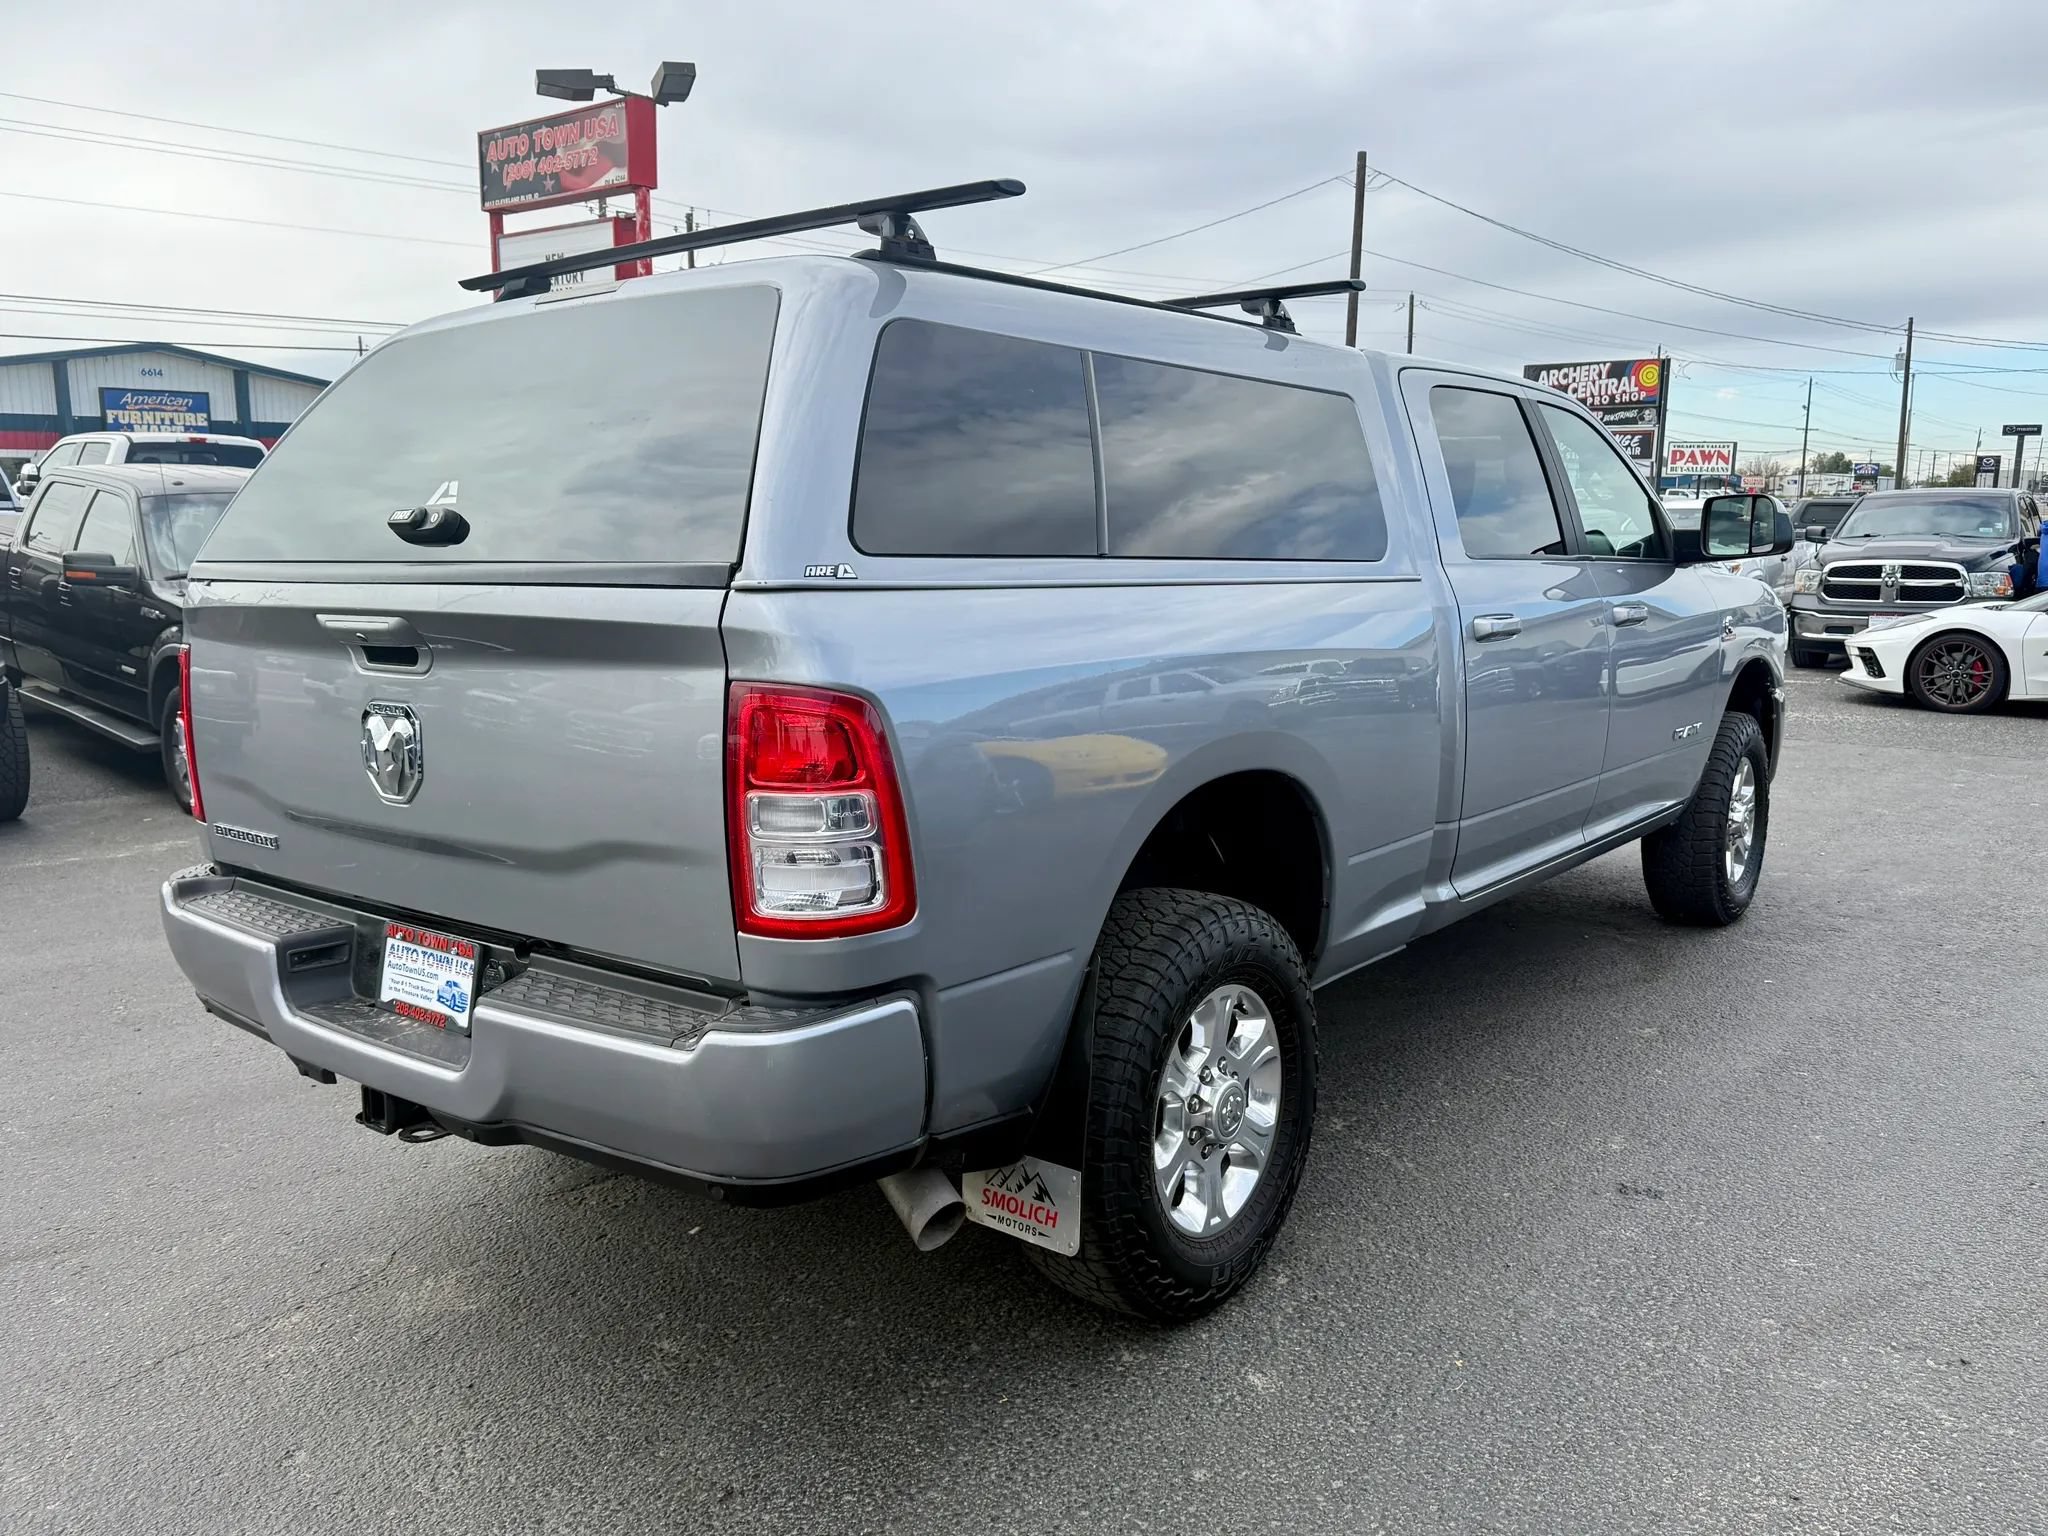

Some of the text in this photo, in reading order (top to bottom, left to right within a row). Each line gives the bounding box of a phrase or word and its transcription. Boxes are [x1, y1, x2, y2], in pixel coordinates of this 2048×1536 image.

[487, 113, 619, 162] AUTO TOWN USA
[502, 145, 599, 187] (208) 402-5772
[140, 367, 163, 376] 6614
[1538, 362, 1612, 387] ARCHERY
[1567, 375, 1640, 400] CENTRAL
[1586, 391, 1647, 407] PRO SHOP
[120, 392, 193, 407] American
[106, 410, 208, 426] FURNITURE
[1669, 449, 1731, 466] PAWN
[804, 565, 836, 577] ARE
[371, 704, 406, 716] RAM
[213, 823, 281, 850] BIGHORN
[387, 924, 474, 958] AUTO TOWN USA
[388, 943, 420, 962] AUTO
[421, 950, 454, 972] TOWN
[387, 960, 439, 981] AutoTownUS.com
[395, 1001, 447, 1029] 208-402-5772
[981, 1188, 1058, 1228] SMOLICH
[997, 1214, 1037, 1236] MOTORS
